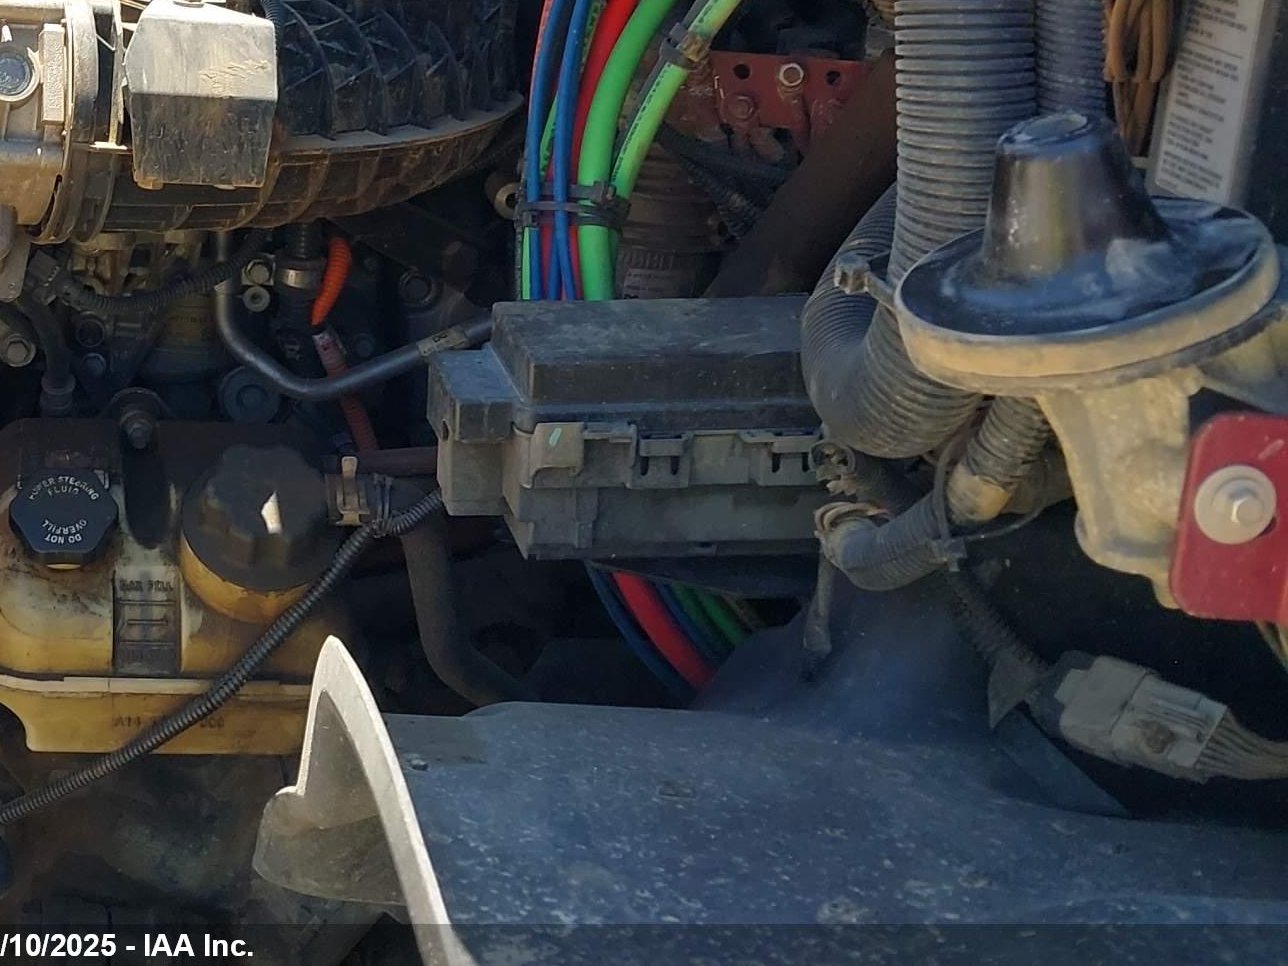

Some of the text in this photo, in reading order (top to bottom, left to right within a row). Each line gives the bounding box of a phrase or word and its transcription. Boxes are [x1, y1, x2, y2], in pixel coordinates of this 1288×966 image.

[41, 519, 88, 536] OVERFILL
[44, 534, 83, 545] DO NOT
